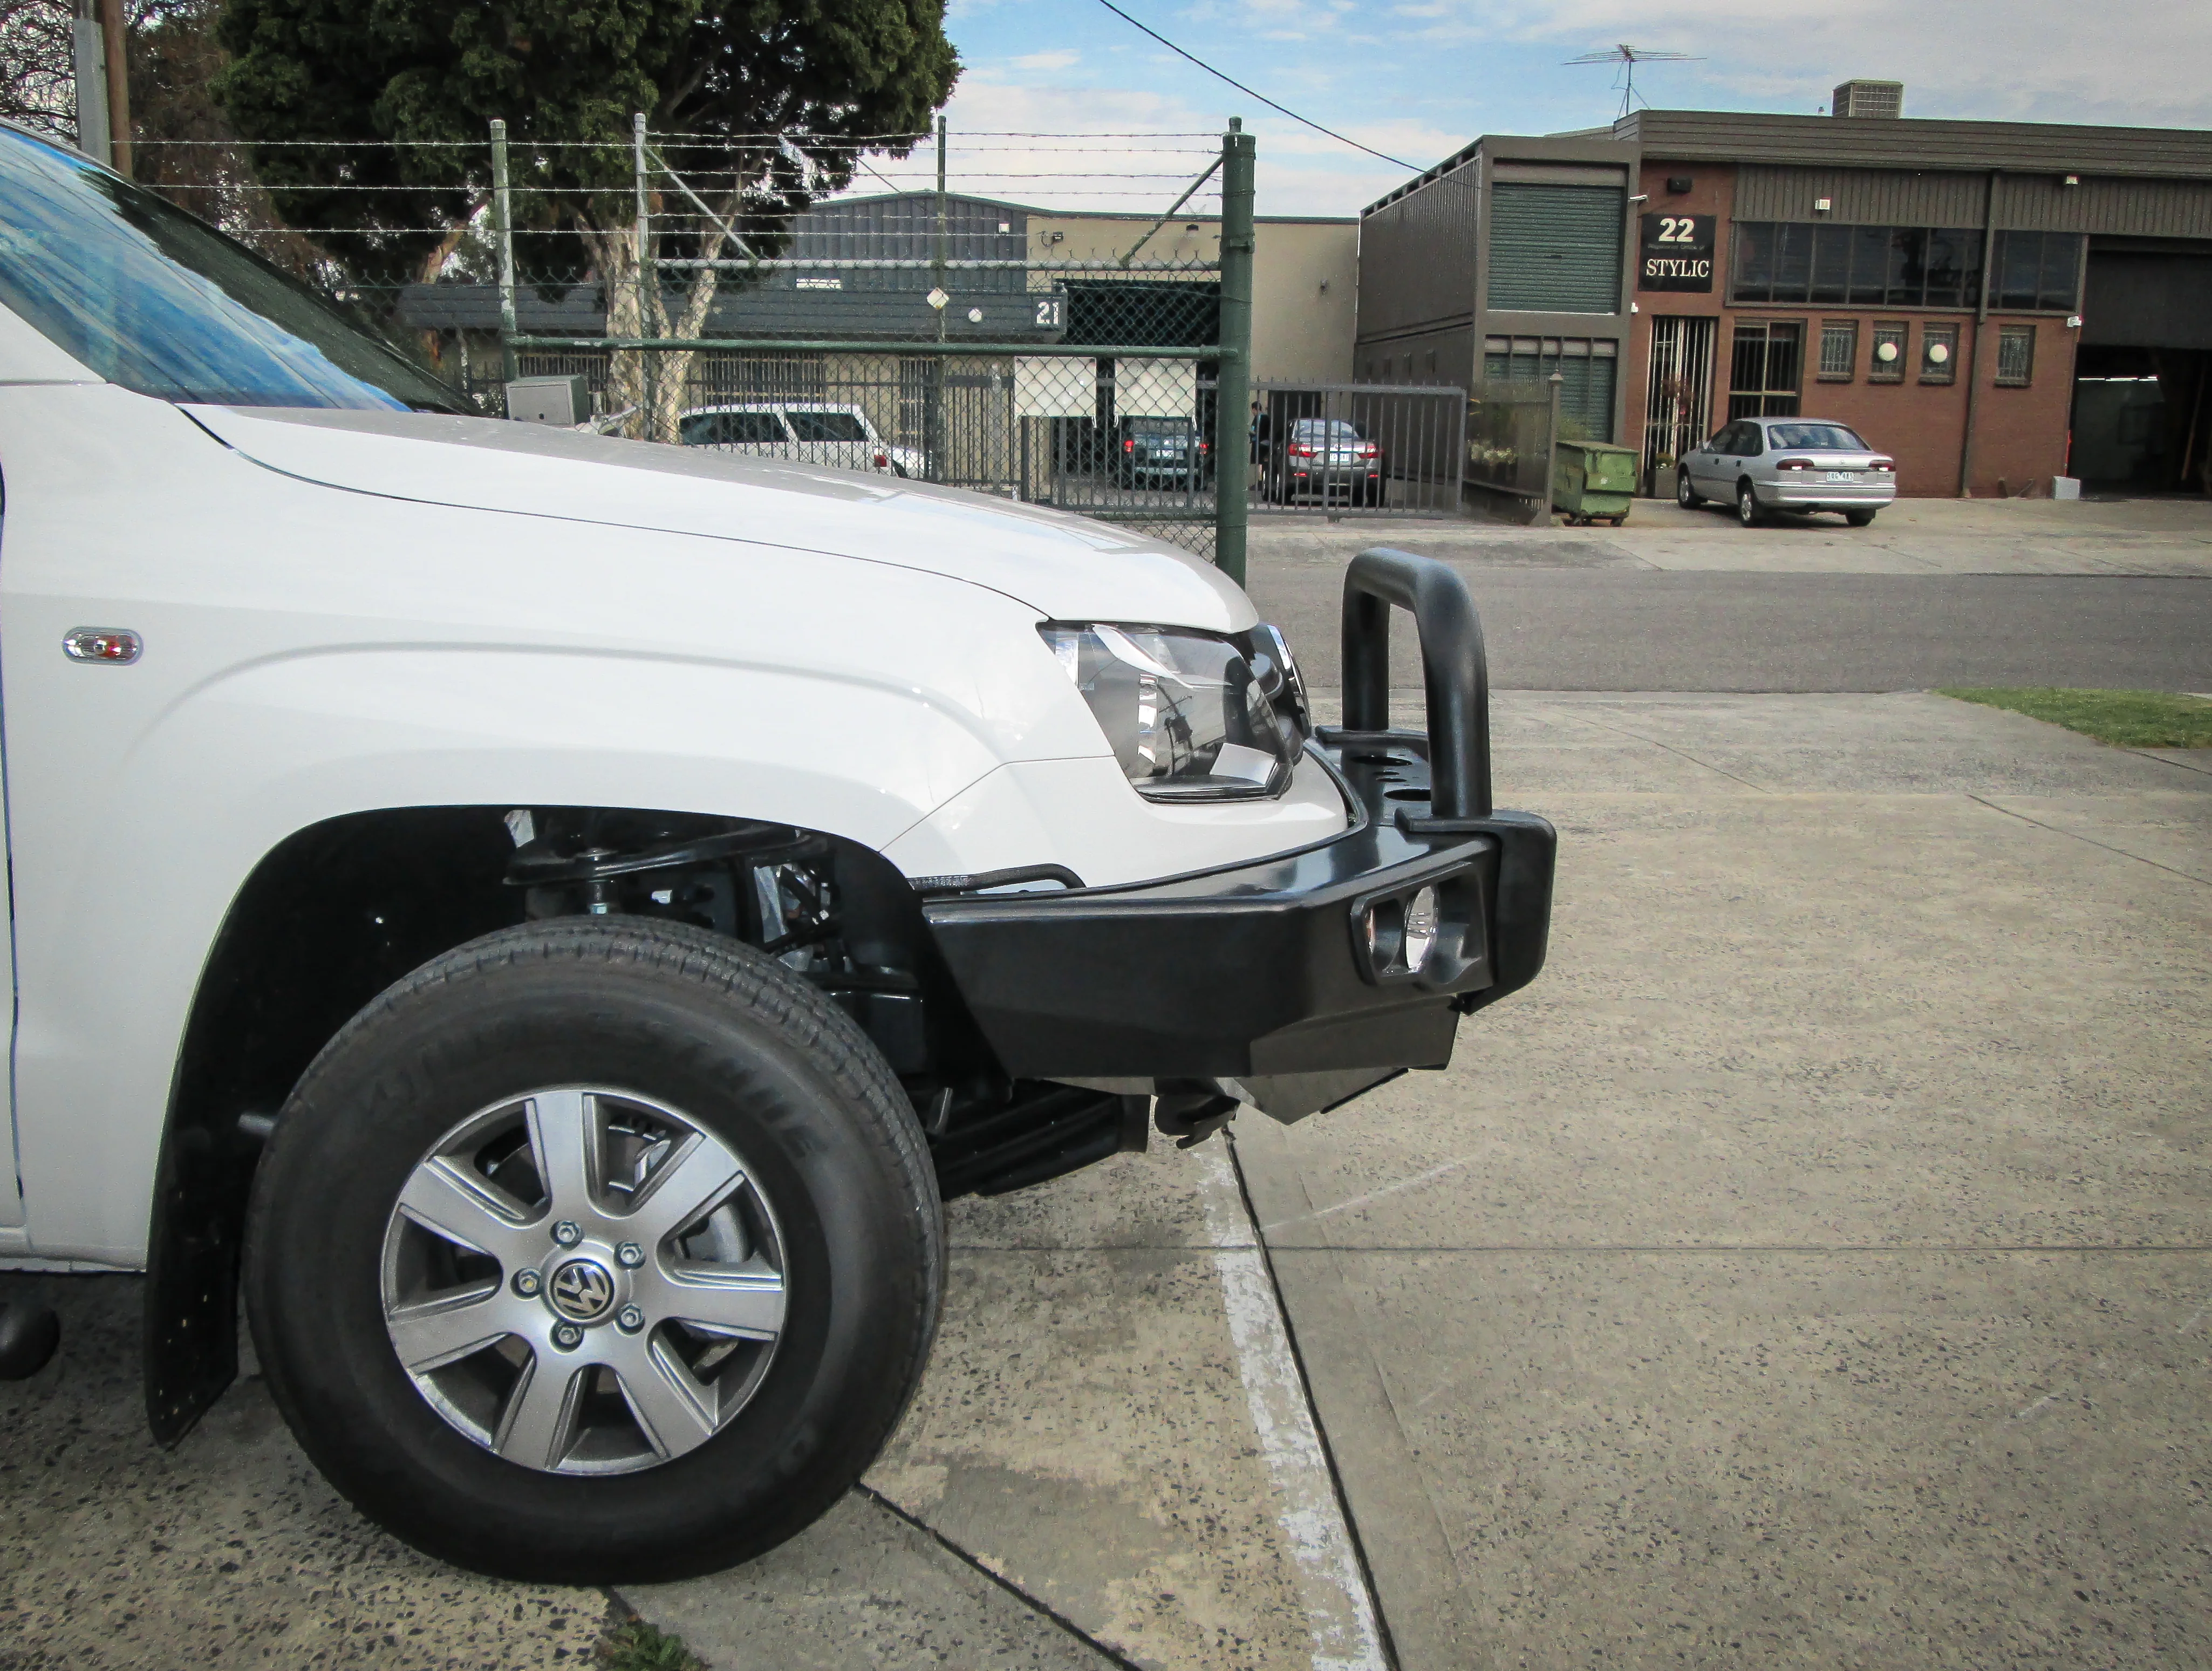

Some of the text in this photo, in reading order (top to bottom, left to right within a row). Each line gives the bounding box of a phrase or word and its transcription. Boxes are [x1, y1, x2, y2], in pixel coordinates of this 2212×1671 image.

[1658, 218, 1694, 242] 22
[1646, 258, 1709, 277] STYLIC
[1036, 301, 1059, 325] 21
